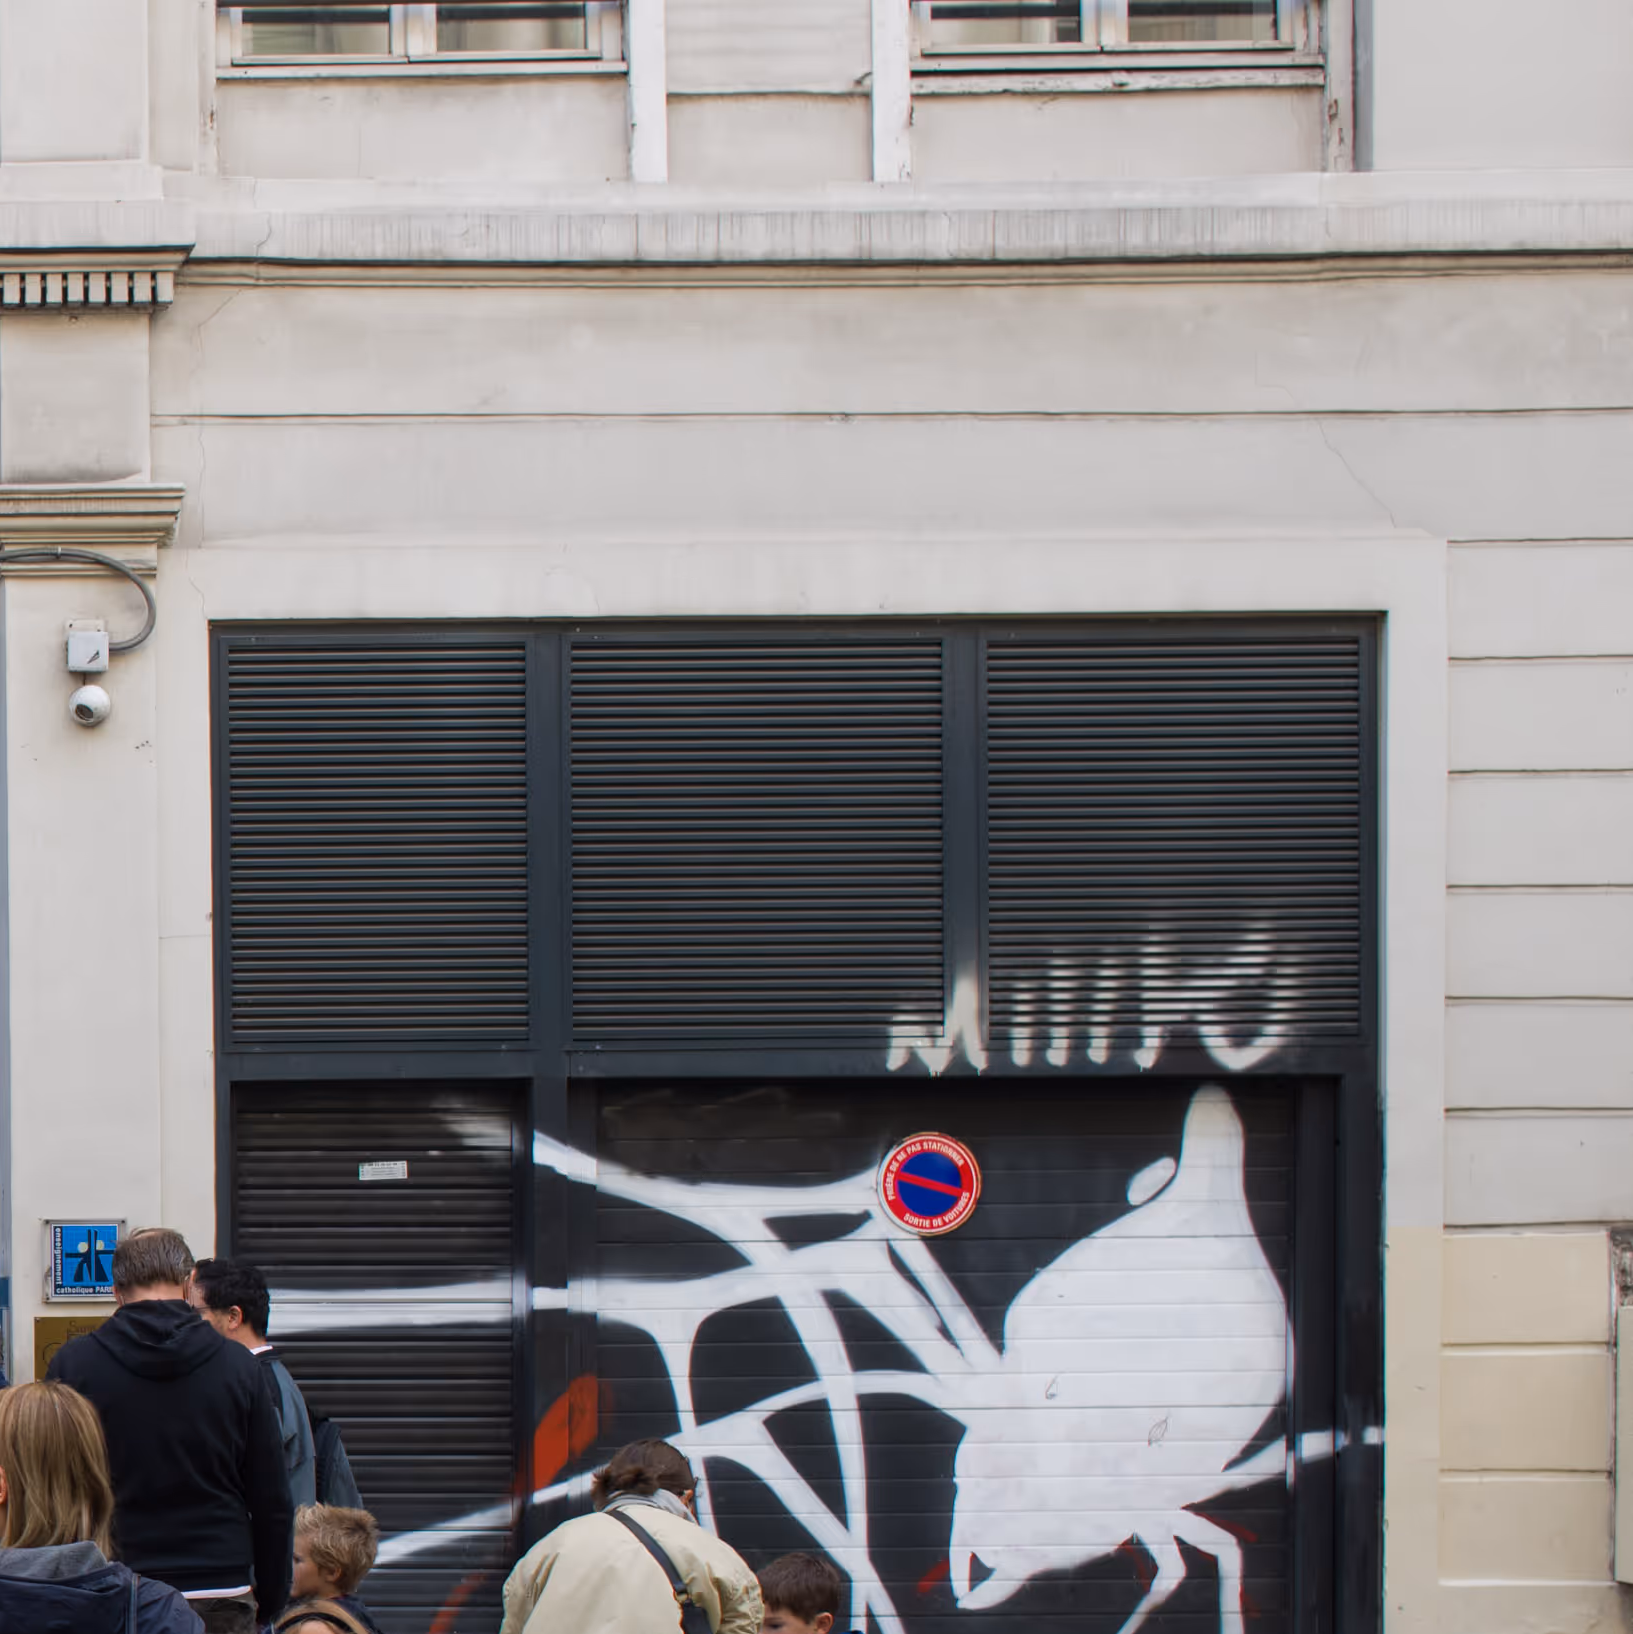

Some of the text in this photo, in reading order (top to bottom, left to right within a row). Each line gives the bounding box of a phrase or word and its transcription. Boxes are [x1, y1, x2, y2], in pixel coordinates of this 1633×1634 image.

[885, 1141, 964, 1201] PRIÈRE DE NE PAS STATIONNER
[903, 1191, 970, 1228] SORTIE DE VOITURES
[55, 1227, 63, 1285] enseignement
[56, 1286, 93, 1295] catholique
